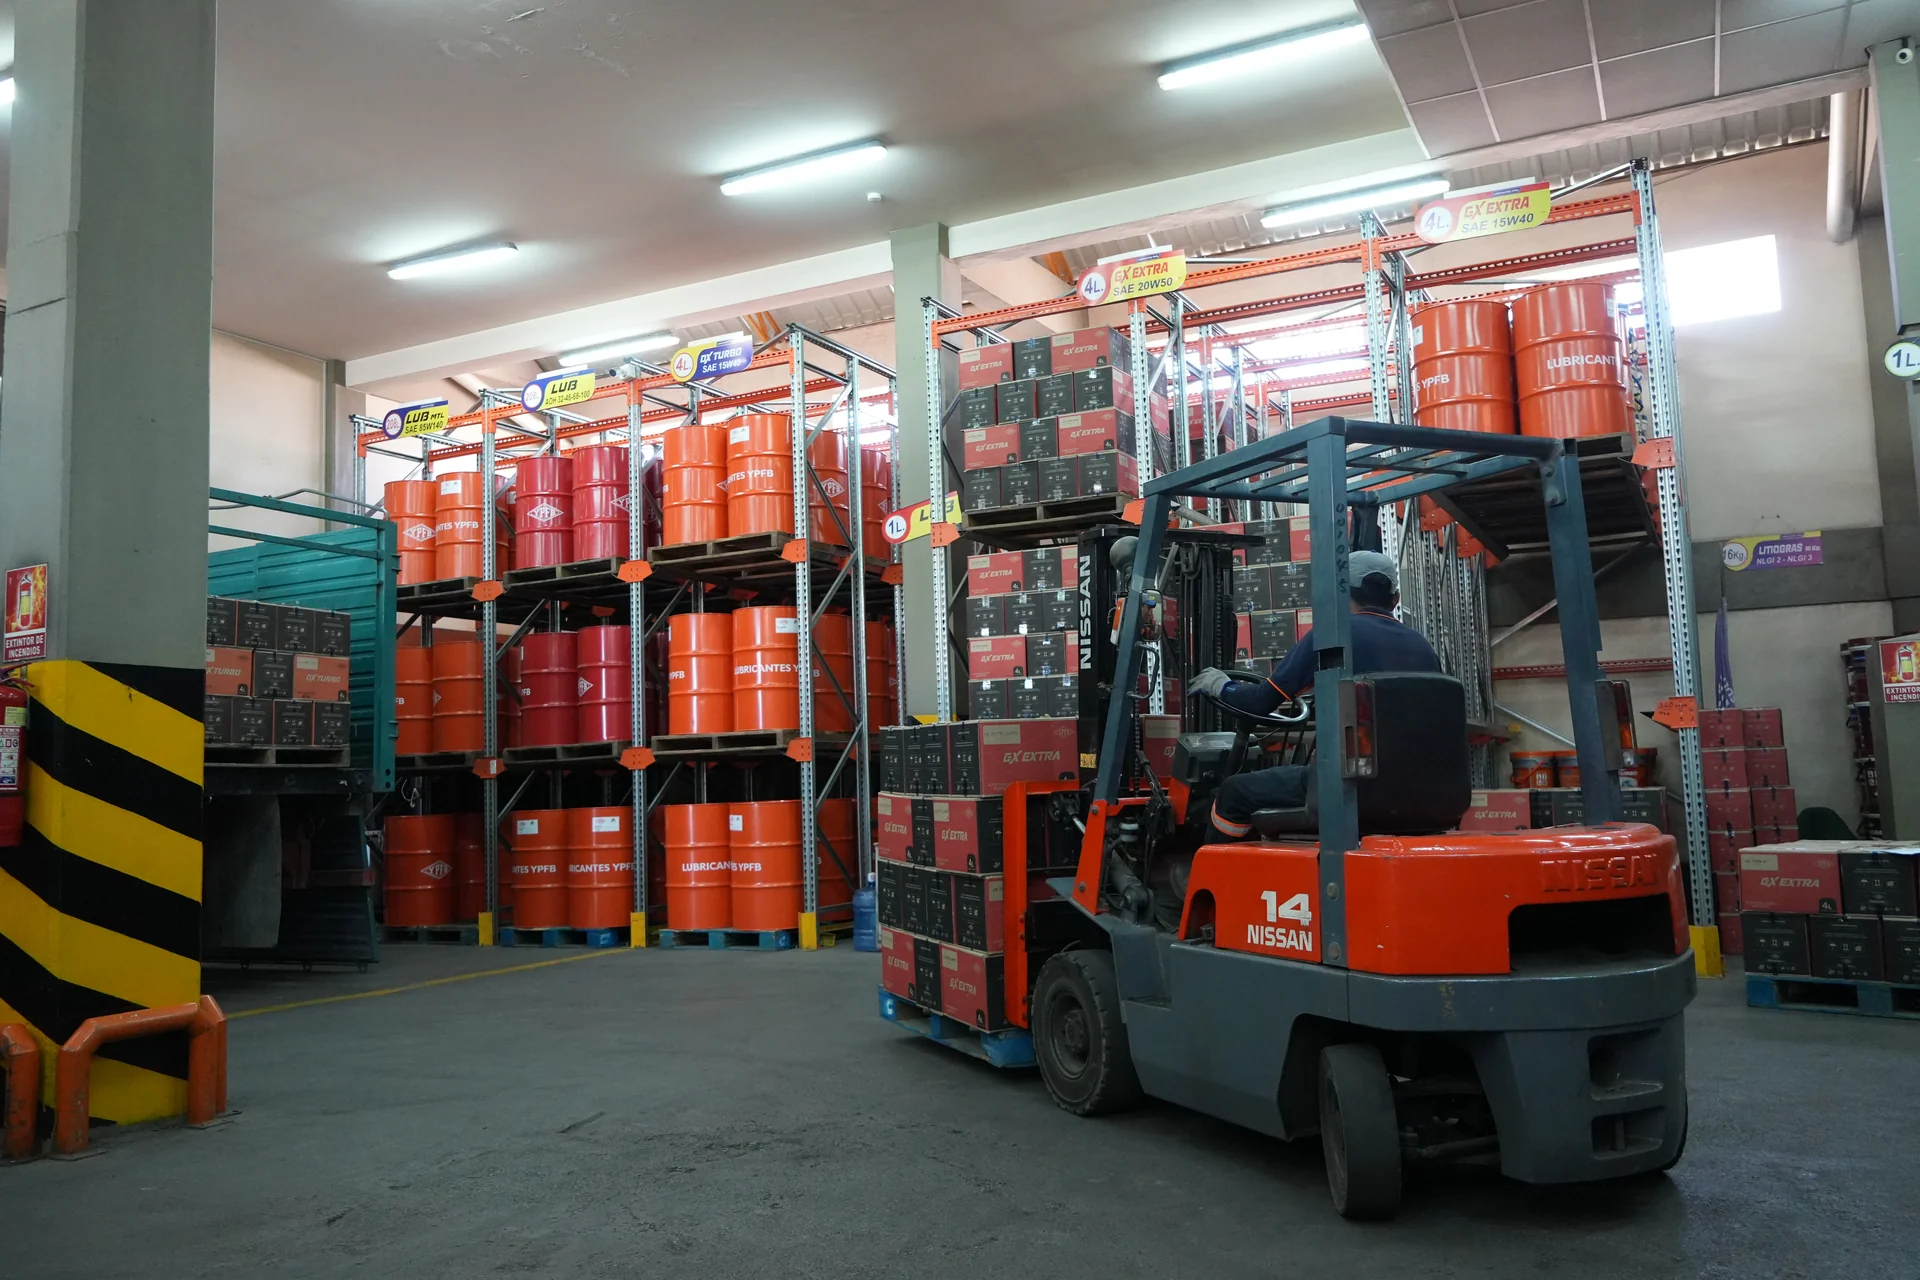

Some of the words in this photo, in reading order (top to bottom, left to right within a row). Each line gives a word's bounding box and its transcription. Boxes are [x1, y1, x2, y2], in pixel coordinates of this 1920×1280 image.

[1464, 201, 1484, 219] GX
[1486, 196, 1529, 214] EXTRA
[1462, 220, 1487, 233] SAE
[1494, 213, 1534, 228] 15W40
[1115, 266, 1131, 283] GX
[1132, 262, 1168, 278] EXTRA
[1113, 284, 1134, 296] SAE
[1138, 277, 1172, 291] 20W50
[714, 348, 742, 360] TURBO
[1074, 345, 1097, 354] EXTRA
[702, 362, 717, 373] SAE
[718, 359, 741, 370] 15W40
[980, 360, 1002, 370] EXTRA
[551, 380, 578, 394] LUB
[1422, 374, 1449, 389] YPFB
[406, 412, 429, 424] LUB
[405, 424, 418, 434] SAE
[419, 420, 444, 432] 85W140
[1081, 427, 1105, 436] EXTRA
[985, 441, 1008, 449] EXTRA
[748, 470, 774, 478] YPFB
[533, 508, 556, 518] YPFB
[410, 527, 432, 538] YPFB
[1080, 555, 1091, 670] NISSAN
[6, 637, 34, 648] EXTINTOR
[36, 635, 44, 643] DE
[9, 646, 40, 658] INCENDIOS
[214, 667, 241, 676] TURBO
[734, 663, 791, 675] LUBRICANTES
[317, 675, 341, 683] TURBO
[1003, 750, 1022, 764] GX
[1022, 751, 1060, 762] EXTRA
[892, 823, 907, 835] EXTRA
[950, 831, 968, 841] EXTRA
[428, 864, 448, 876] YPFB
[531, 864, 556, 873] YPFB
[738, 863, 762, 871] YPFB
[1540, 854, 1658, 892] NISSAN
[1761, 876, 1779, 887] GX
[1779, 878, 1820, 887] EXTRA
[1261, 890, 1312, 926] 14
[1822, 902, 1832, 910] 4L
[1247, 924, 1312, 952] NISSAN
[894, 958, 908, 970] EXTRA
[958, 982, 977, 995] EXTRA
